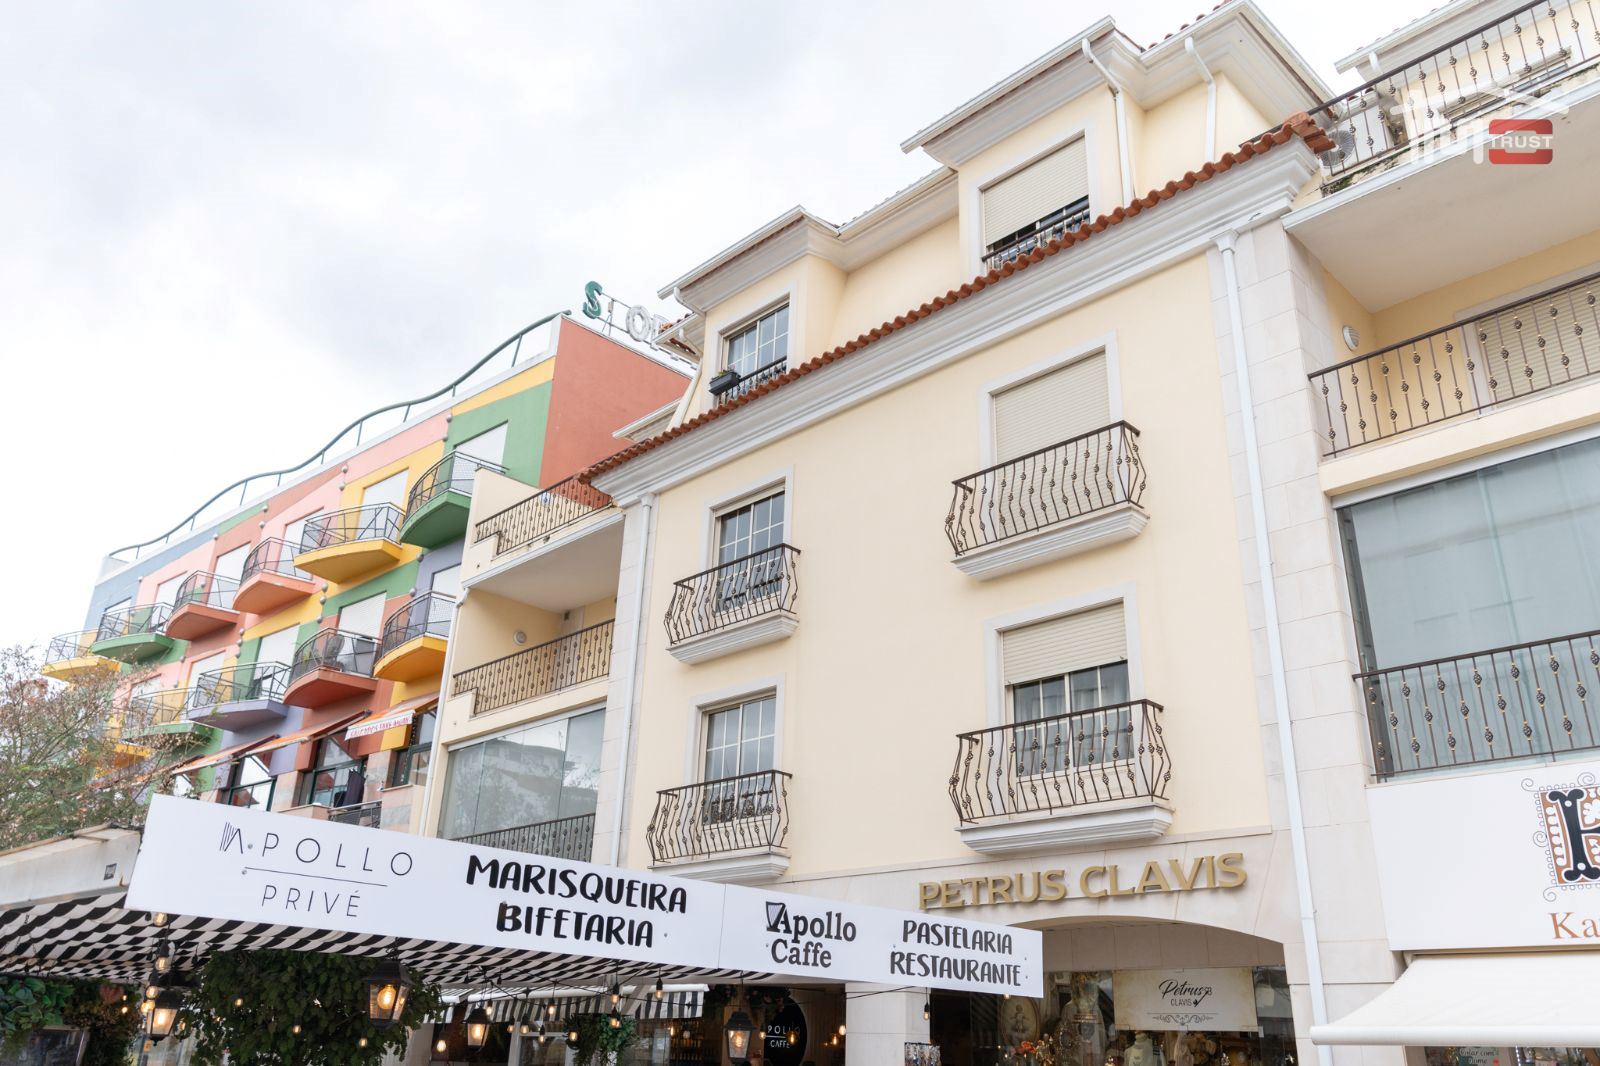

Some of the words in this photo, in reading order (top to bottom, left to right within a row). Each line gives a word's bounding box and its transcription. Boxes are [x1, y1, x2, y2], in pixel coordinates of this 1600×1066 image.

[220, 821, 413, 877] APOLLO
[466, 854, 687, 914] MARISQUEIRA
[919, 869, 1067, 910] PETRUS
[1080, 852, 1248, 898] CLAVIS
[261, 884, 362, 918] PRIVÉ
[496, 902, 654, 948] BIFETARIA
[765, 901, 857, 945] Apollo
[902, 919, 1013, 955] PASTELARIA
[770, 938, 833, 968] Caffe
[890, 951, 1022, 987] RESTAURANTE
[1158, 979, 1206, 999] Petrus
[1170, 998, 1193, 1007] CLAVIS
